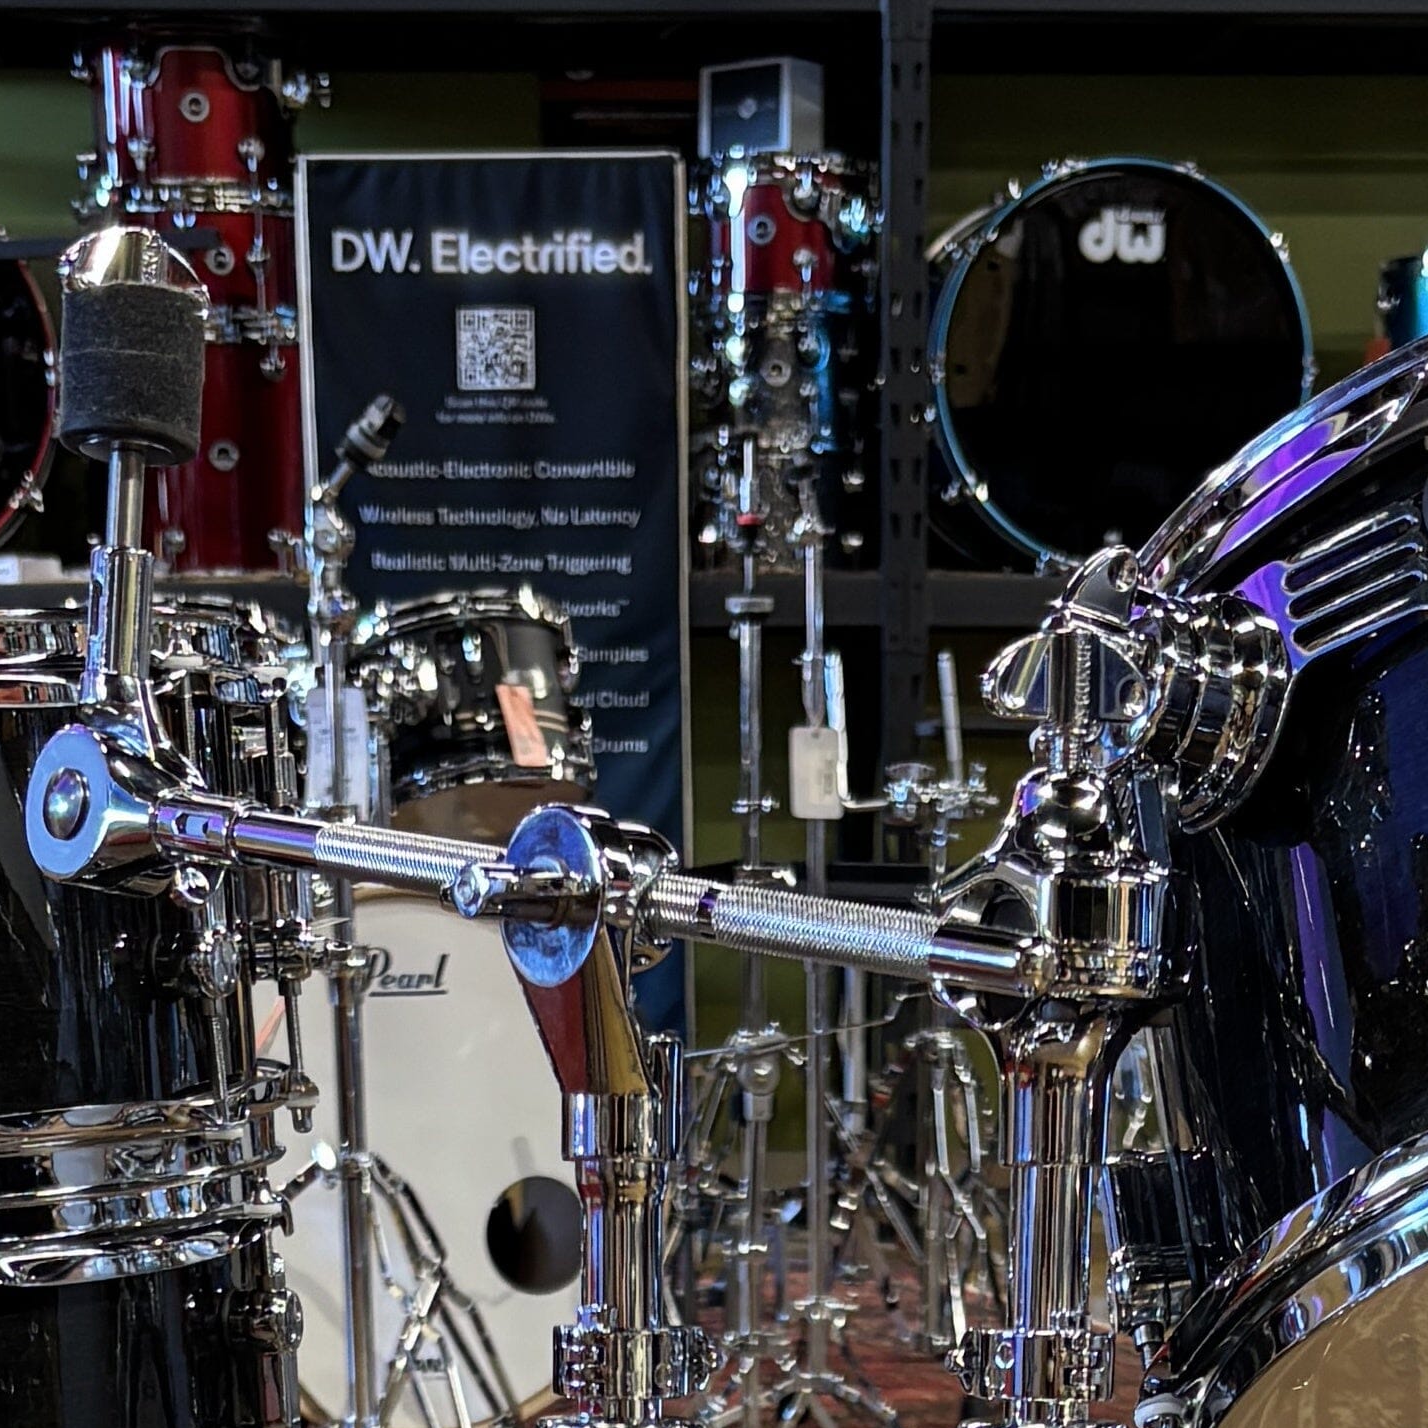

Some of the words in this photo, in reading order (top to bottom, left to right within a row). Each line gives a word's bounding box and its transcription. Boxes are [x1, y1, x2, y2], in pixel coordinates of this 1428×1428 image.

[332, 229, 420, 273] DW.
[430, 228, 653, 274] Electrified.
[1078, 206, 1166, 264] dw
[533, 460, 636, 479] Convertible
[358, 505, 435, 526] Wireless
[372, 553, 446, 571] Realistic
[365, 945, 450, 989] Pearl
